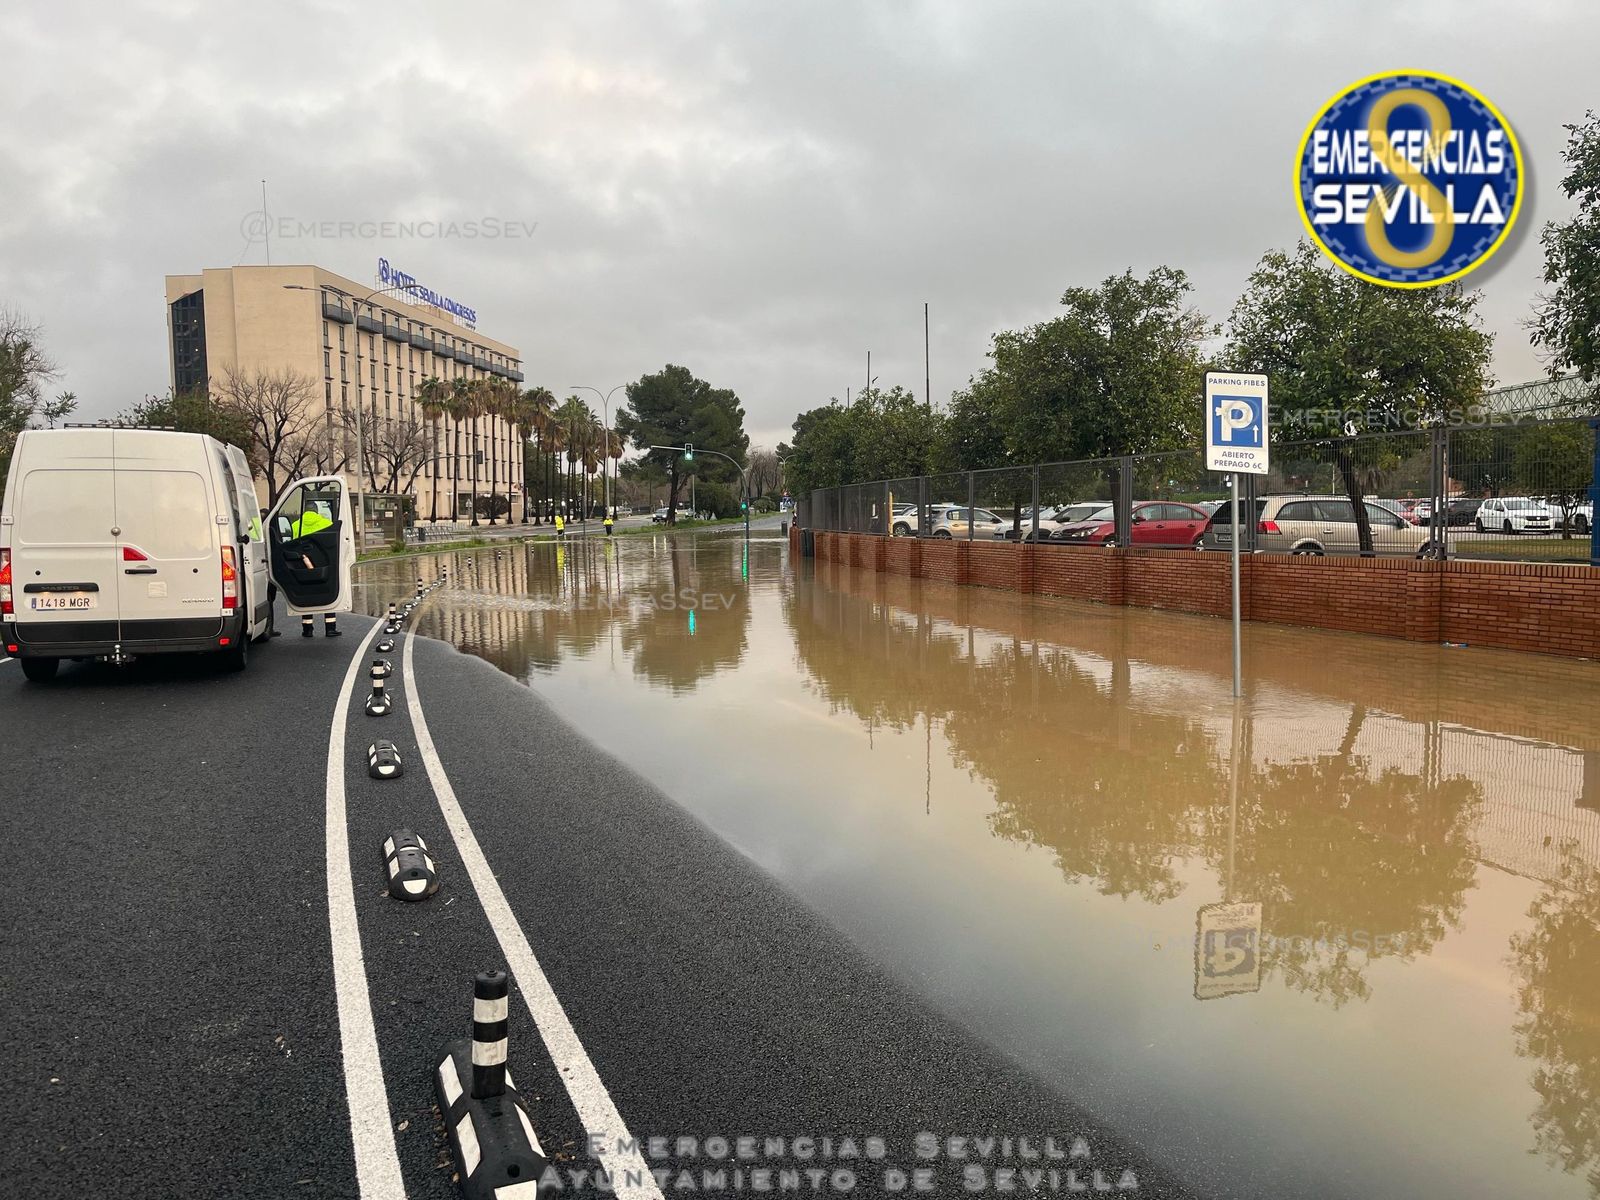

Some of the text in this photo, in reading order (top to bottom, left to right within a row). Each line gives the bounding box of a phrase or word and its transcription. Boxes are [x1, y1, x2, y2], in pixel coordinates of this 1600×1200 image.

[391, 268, 477, 323] HOTEL SEVILLA CONGRESOS
[1208, 378, 1265, 387] PARKING FIBES
[1222, 451, 1254, 460] ABIERTO
[1214, 459, 1250, 469] PREPAGO
[40, 598, 65, 608] 1418
[69, 597, 90, 607] MGR
